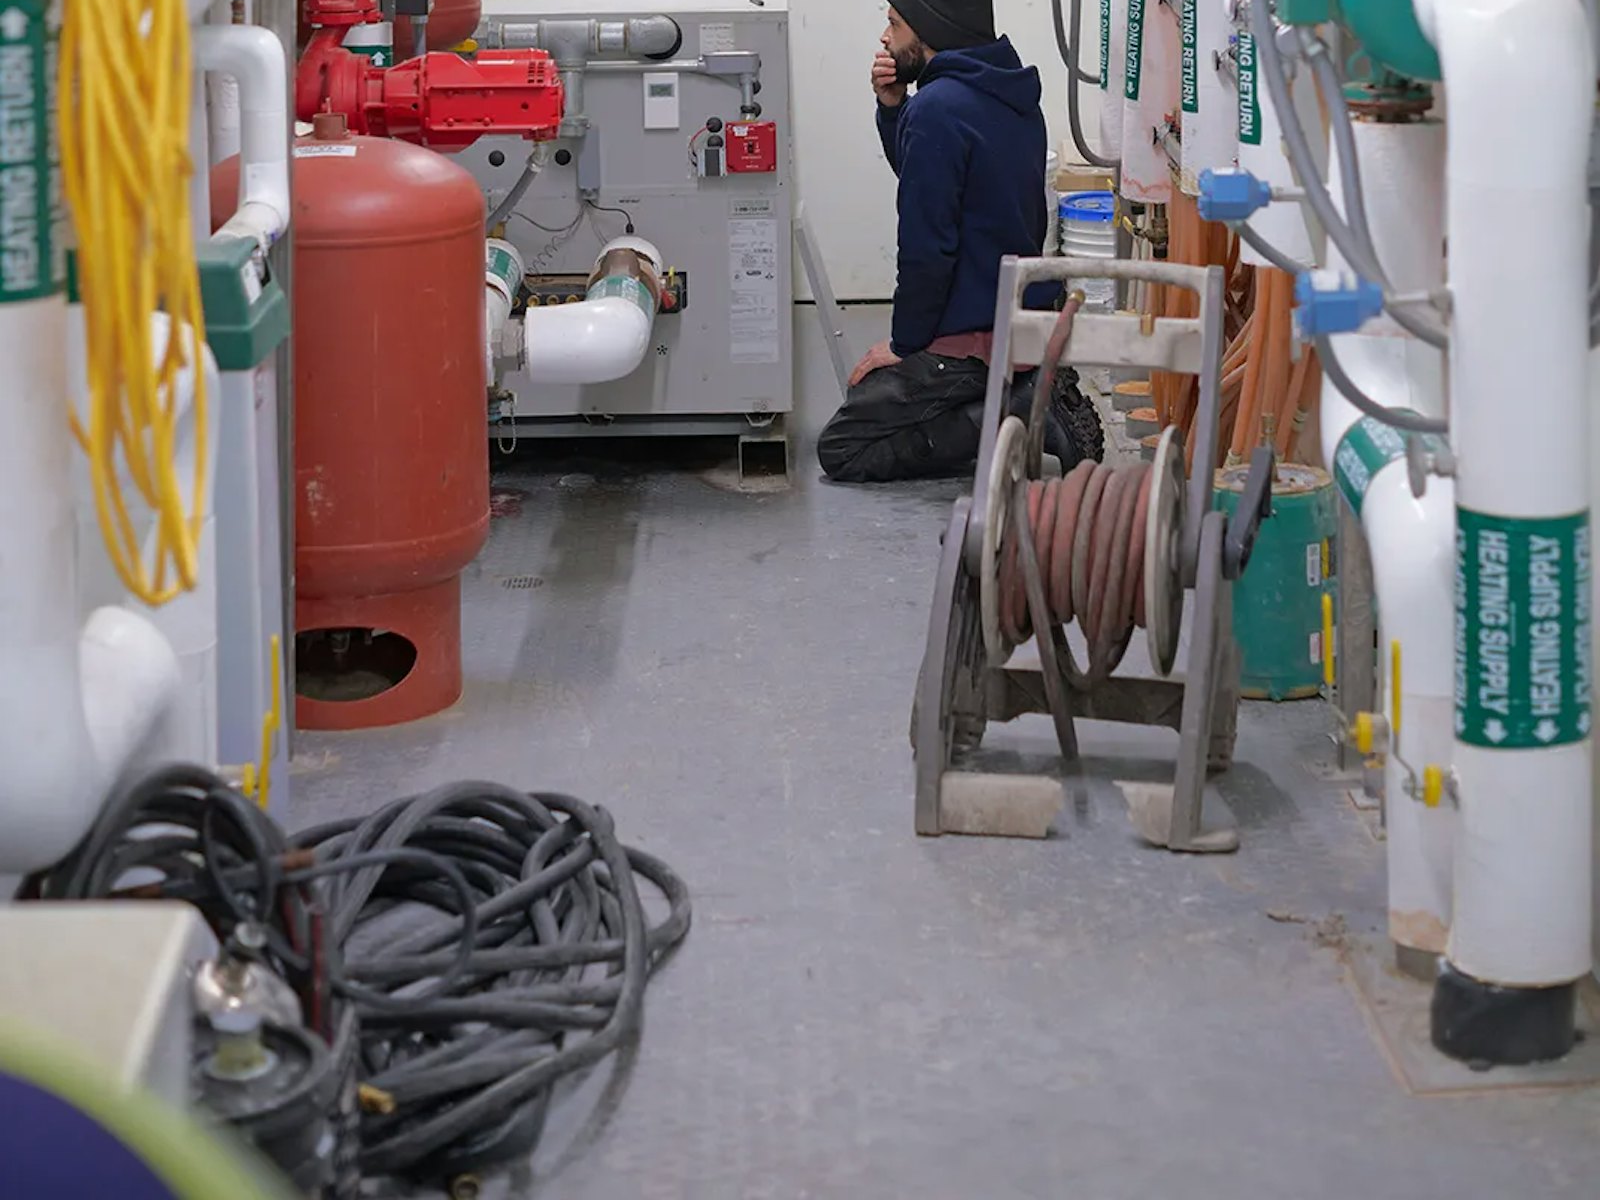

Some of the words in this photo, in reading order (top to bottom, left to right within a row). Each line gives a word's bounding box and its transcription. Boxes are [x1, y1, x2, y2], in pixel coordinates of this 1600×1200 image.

[1099, 17, 1110, 71] HEATING
[1126, 21, 1141, 79] HEATING
[1182, 46, 1195, 105] RETURN
[1239, 31, 1253, 67] TING
[0, 43, 35, 163] RETURN
[1239, 69, 1253, 137] RETURN
[0, 164, 40, 292] HEATING
[1478, 530, 1510, 627] HEATING
[1528, 533, 1562, 619] SUPPLY
[1478, 628, 1510, 715] SUPPLY
[1529, 620, 1562, 716] HEATING
